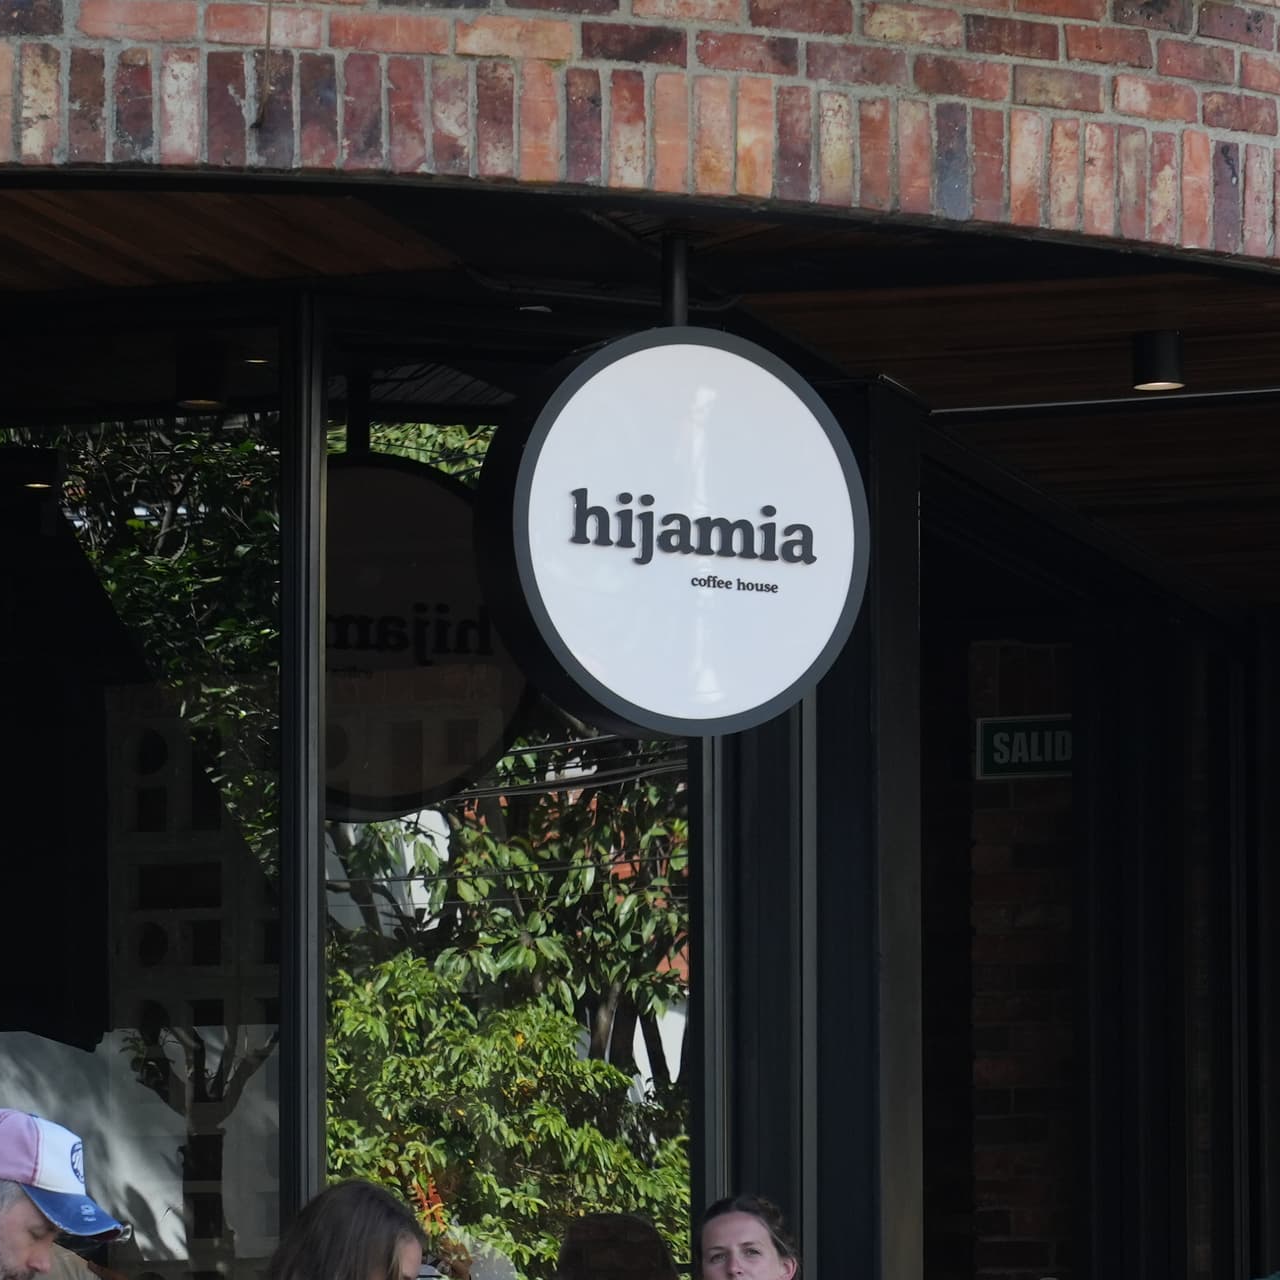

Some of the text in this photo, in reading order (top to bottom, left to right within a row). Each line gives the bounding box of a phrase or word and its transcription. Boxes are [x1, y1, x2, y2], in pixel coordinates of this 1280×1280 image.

[570, 487, 818, 565] hijamia
[690, 575, 779, 594] coffee house
